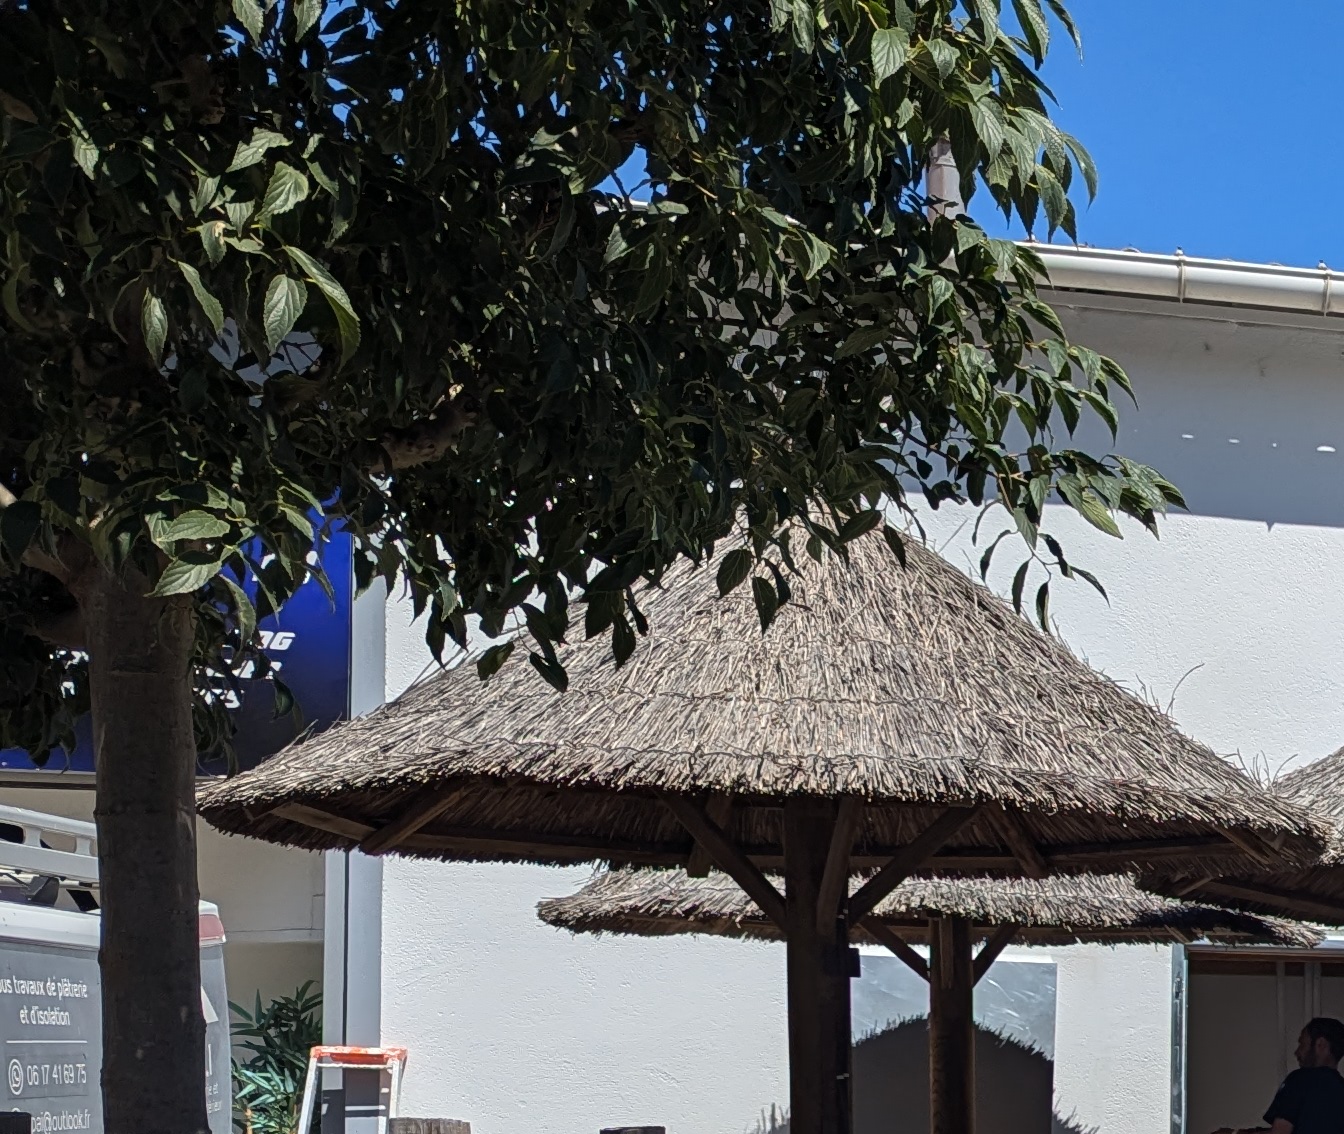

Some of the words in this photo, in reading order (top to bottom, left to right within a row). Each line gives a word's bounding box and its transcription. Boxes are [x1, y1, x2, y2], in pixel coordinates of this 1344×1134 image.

[12, 974, 46, 996] travaux
[46, 975, 57, 997] de
[58, 977, 88, 1001] plâtrerie
[20, 1005, 29, 1024] et
[30, 1005, 70, 1026] d'isolation
[27, 1065, 39, 1086] 06
[41, 1064, 50, 1085] 17
[52, 1064, 63, 1085] 41
[63, 1063, 75, 1084] 69
[75, 1063, 87, 1084] 75
